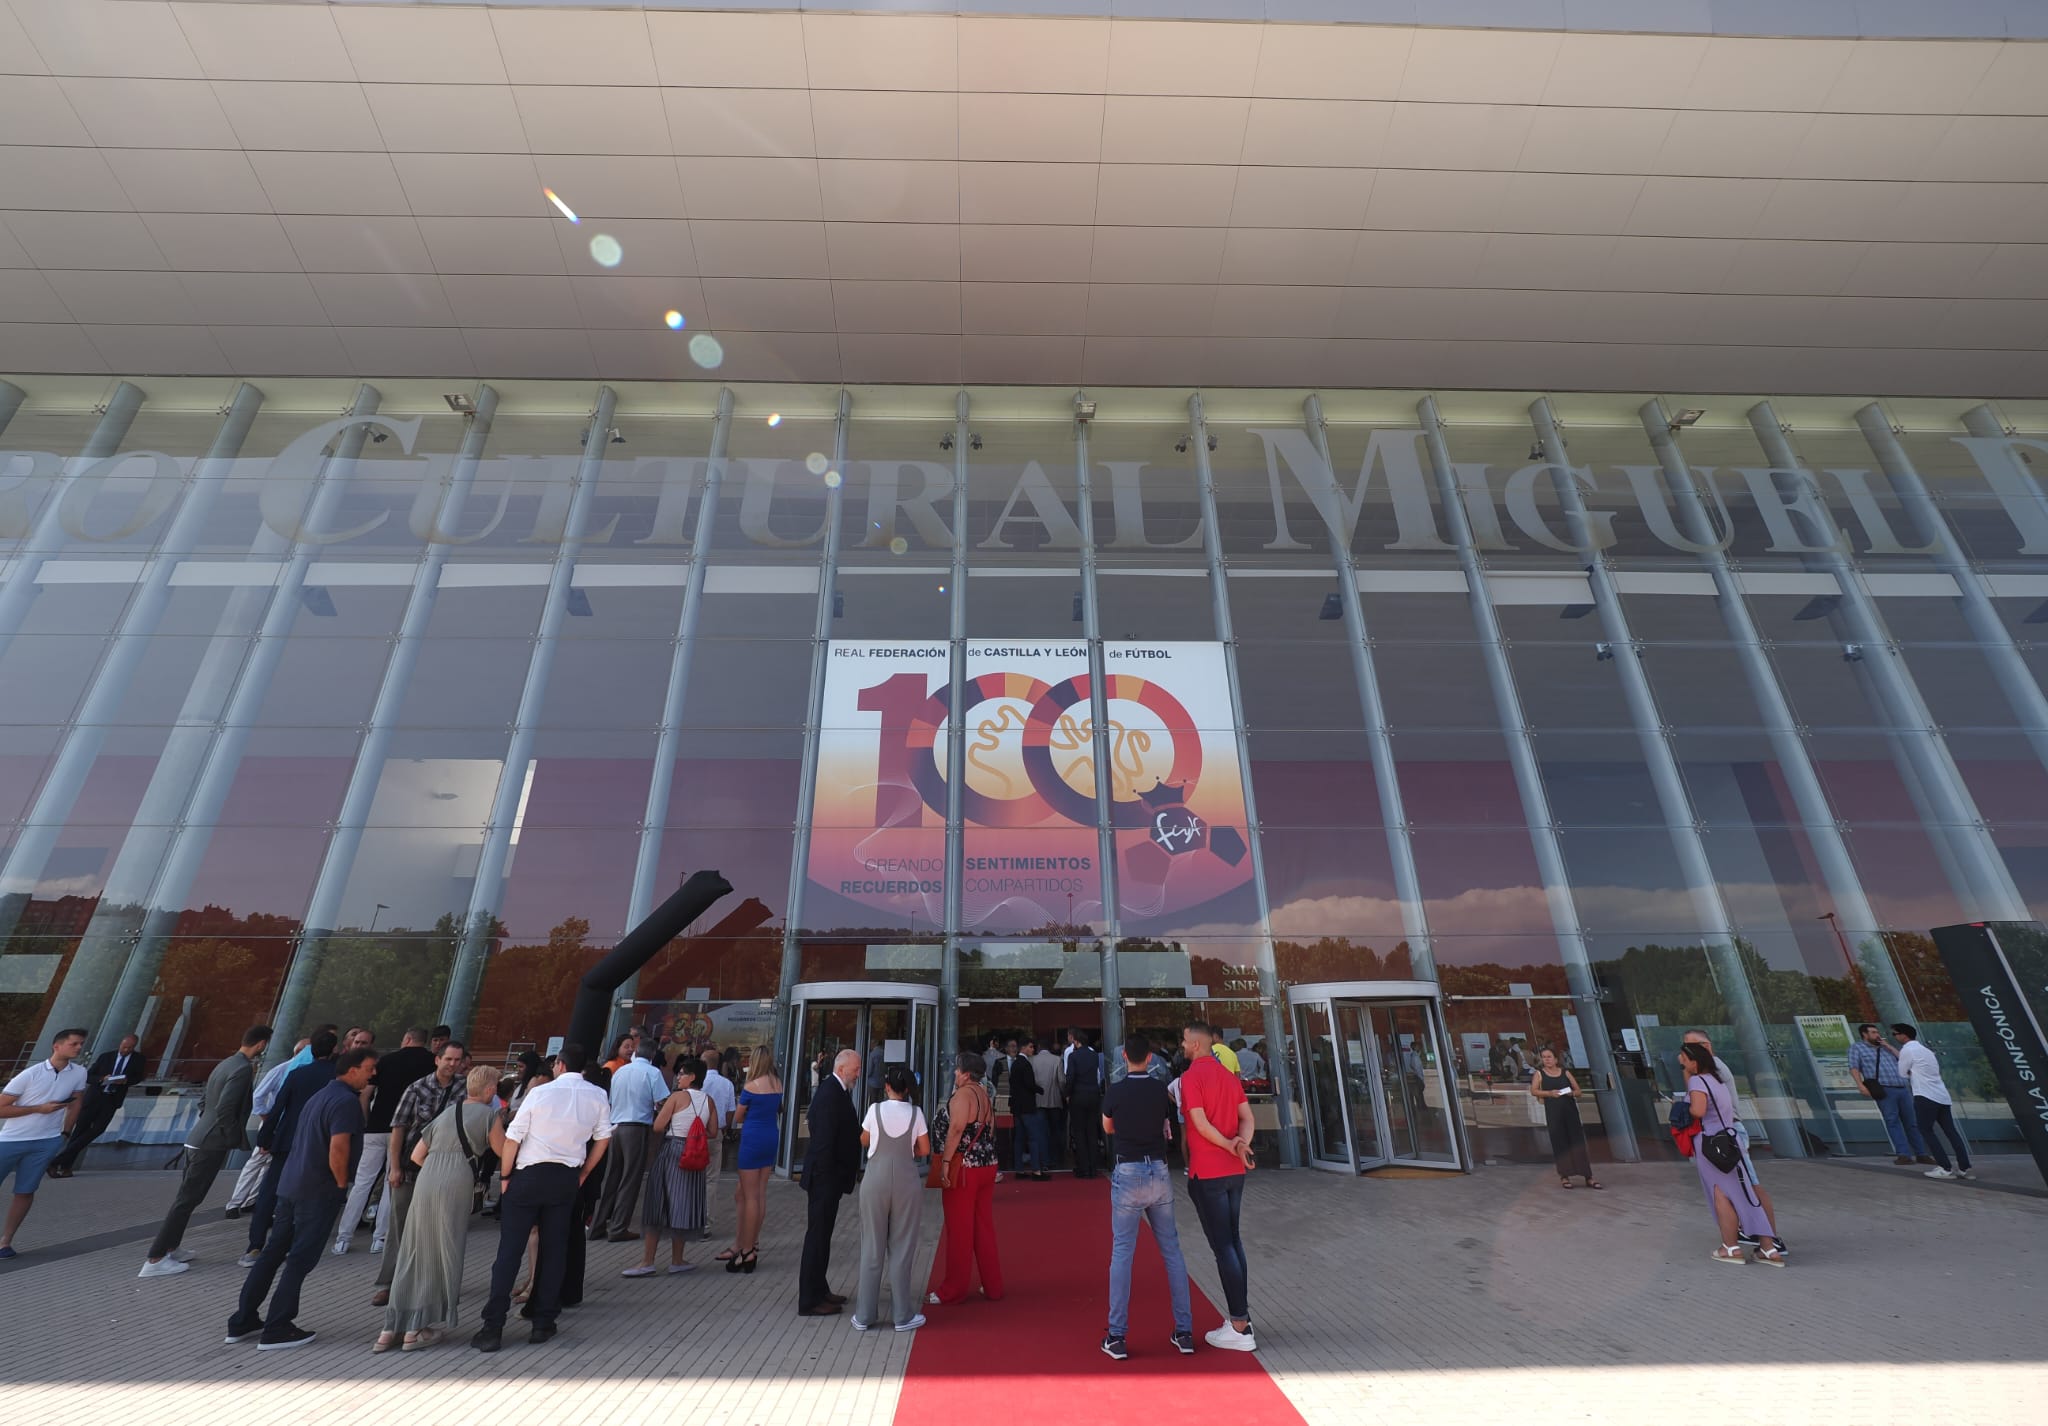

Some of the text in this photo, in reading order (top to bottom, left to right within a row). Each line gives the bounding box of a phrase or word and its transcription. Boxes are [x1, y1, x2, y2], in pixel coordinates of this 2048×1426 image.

[1246, 428, 1943, 555] MIGUEL
[834, 646, 1172, 659] REAL FEDERACIÓN de CASTILLA Y LEÓN de FÚTBOL
[857, 672, 1203, 830] 100
[864, 857, 1091, 872] CREANDO SENTIMIENTOS
[840, 878, 1084, 894] RECUERDOS COMPARTIDOS
[1222, 964, 1258, 976] SALA
[1979, 985, 2036, 1082] SINFÓNICA
